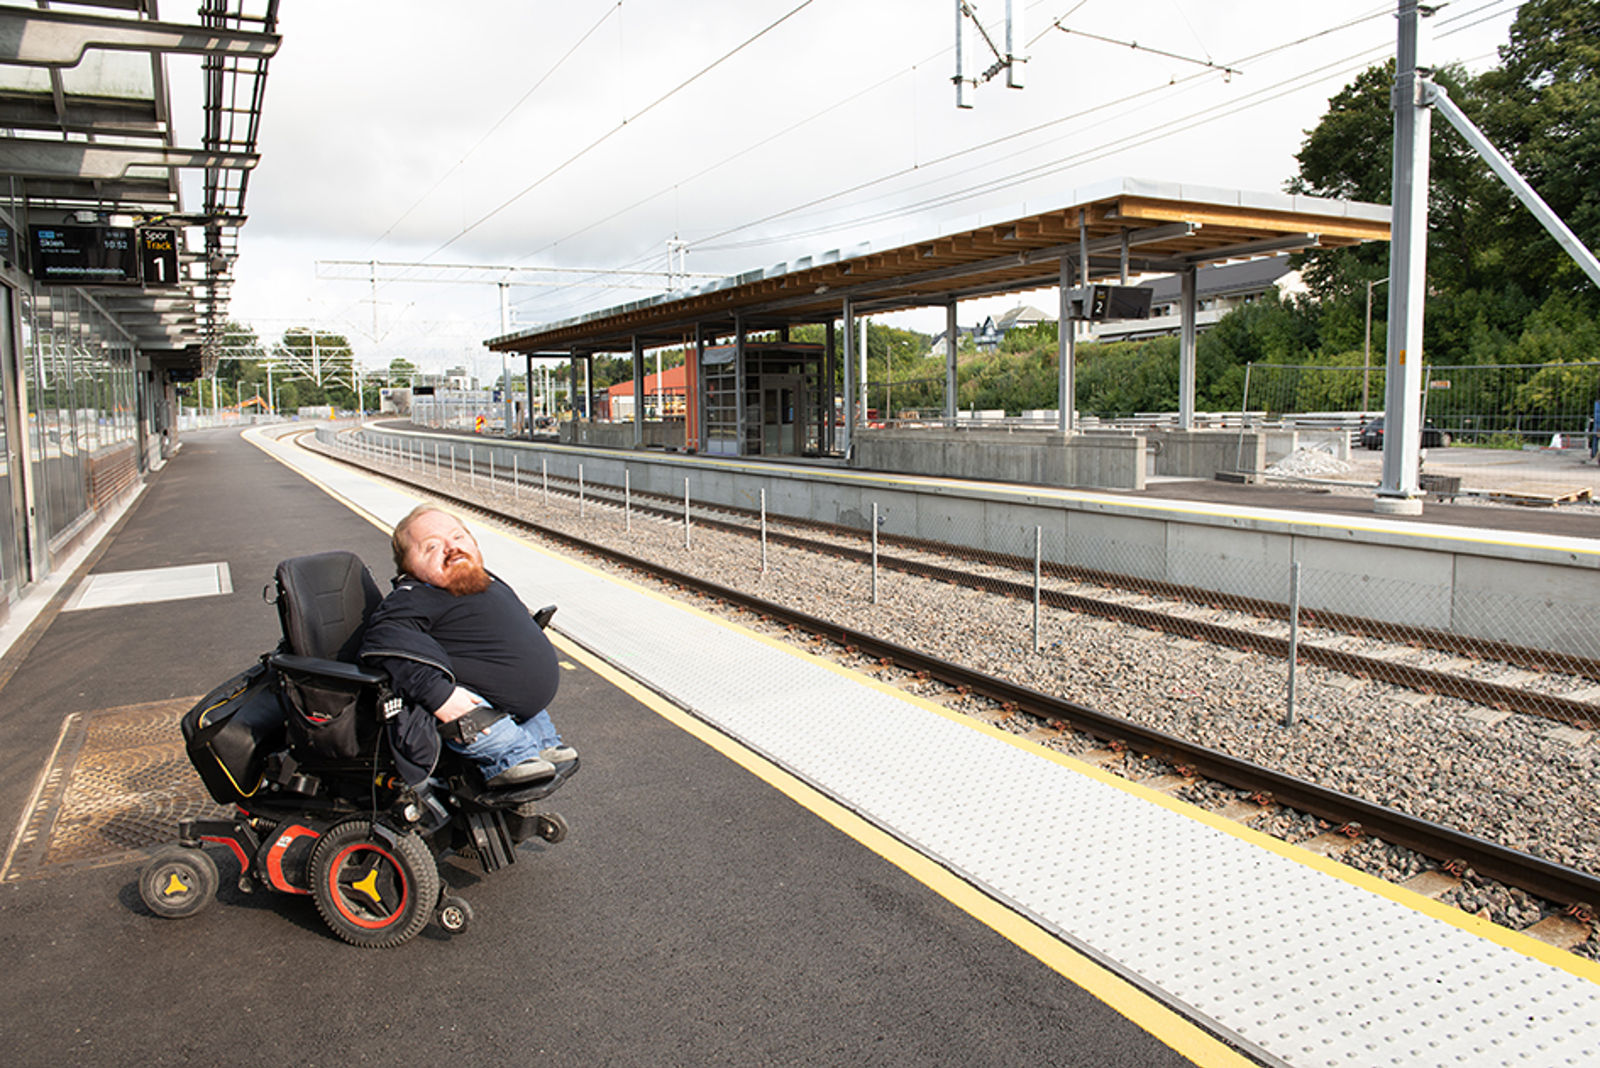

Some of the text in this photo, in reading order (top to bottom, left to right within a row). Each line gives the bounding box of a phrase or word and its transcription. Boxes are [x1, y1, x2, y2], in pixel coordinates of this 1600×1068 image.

[145, 231, 167, 241] Spor
[146, 240, 172, 250] Track
[153, 256, 165, 282] 1
[1095, 301, 1103, 313] 2
